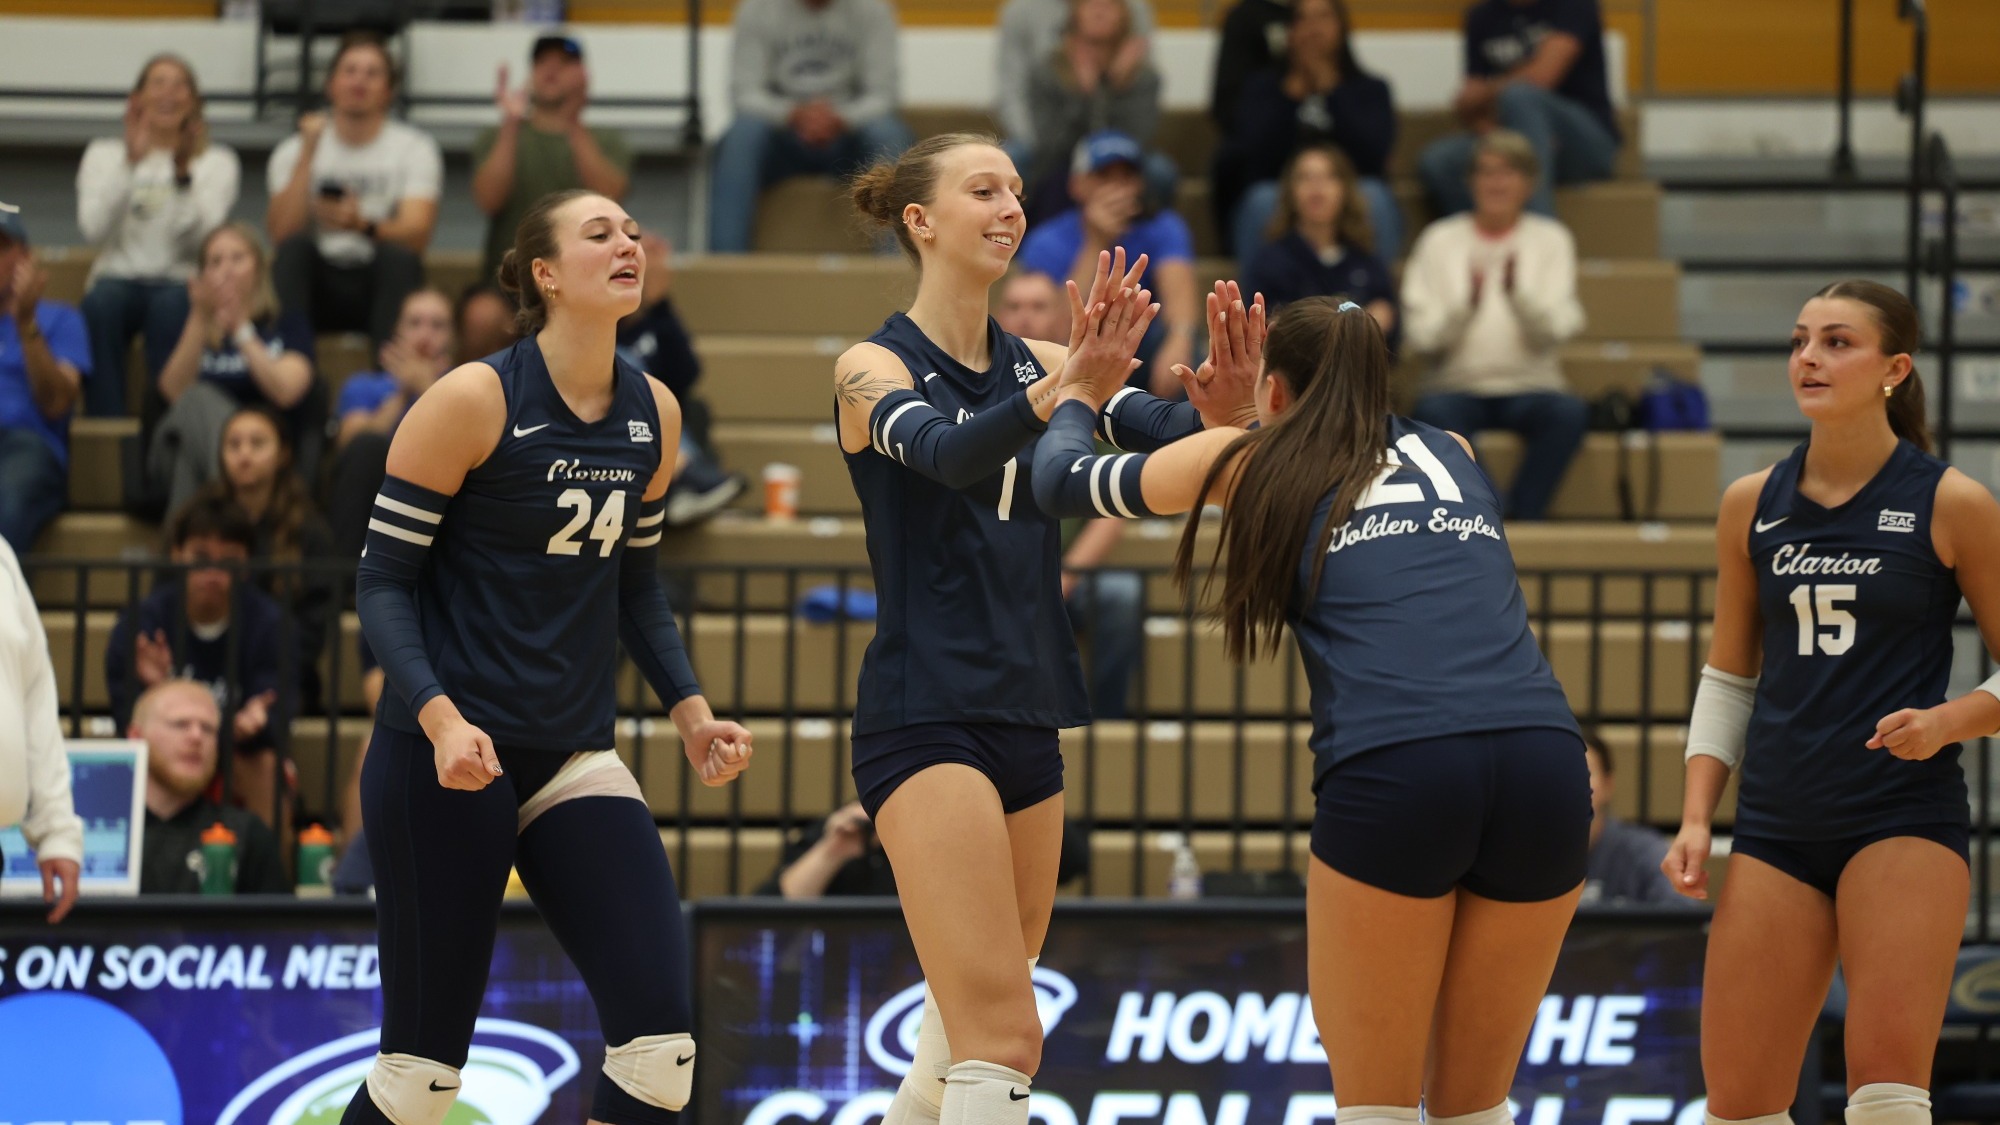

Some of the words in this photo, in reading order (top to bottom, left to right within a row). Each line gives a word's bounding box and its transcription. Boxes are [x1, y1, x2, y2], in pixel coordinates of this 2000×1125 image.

[1354, 433, 1464, 511] 21
[546, 488, 627, 558] 24
[1427, 507, 1501, 541] Eagles
[1878, 515, 1916, 528] PSAC
[1771, 543, 1883, 576] Clarion
[1788, 584, 1857, 656] 15
[15, 945, 94, 990] ON
[98, 945, 273, 990] SOCIAL
